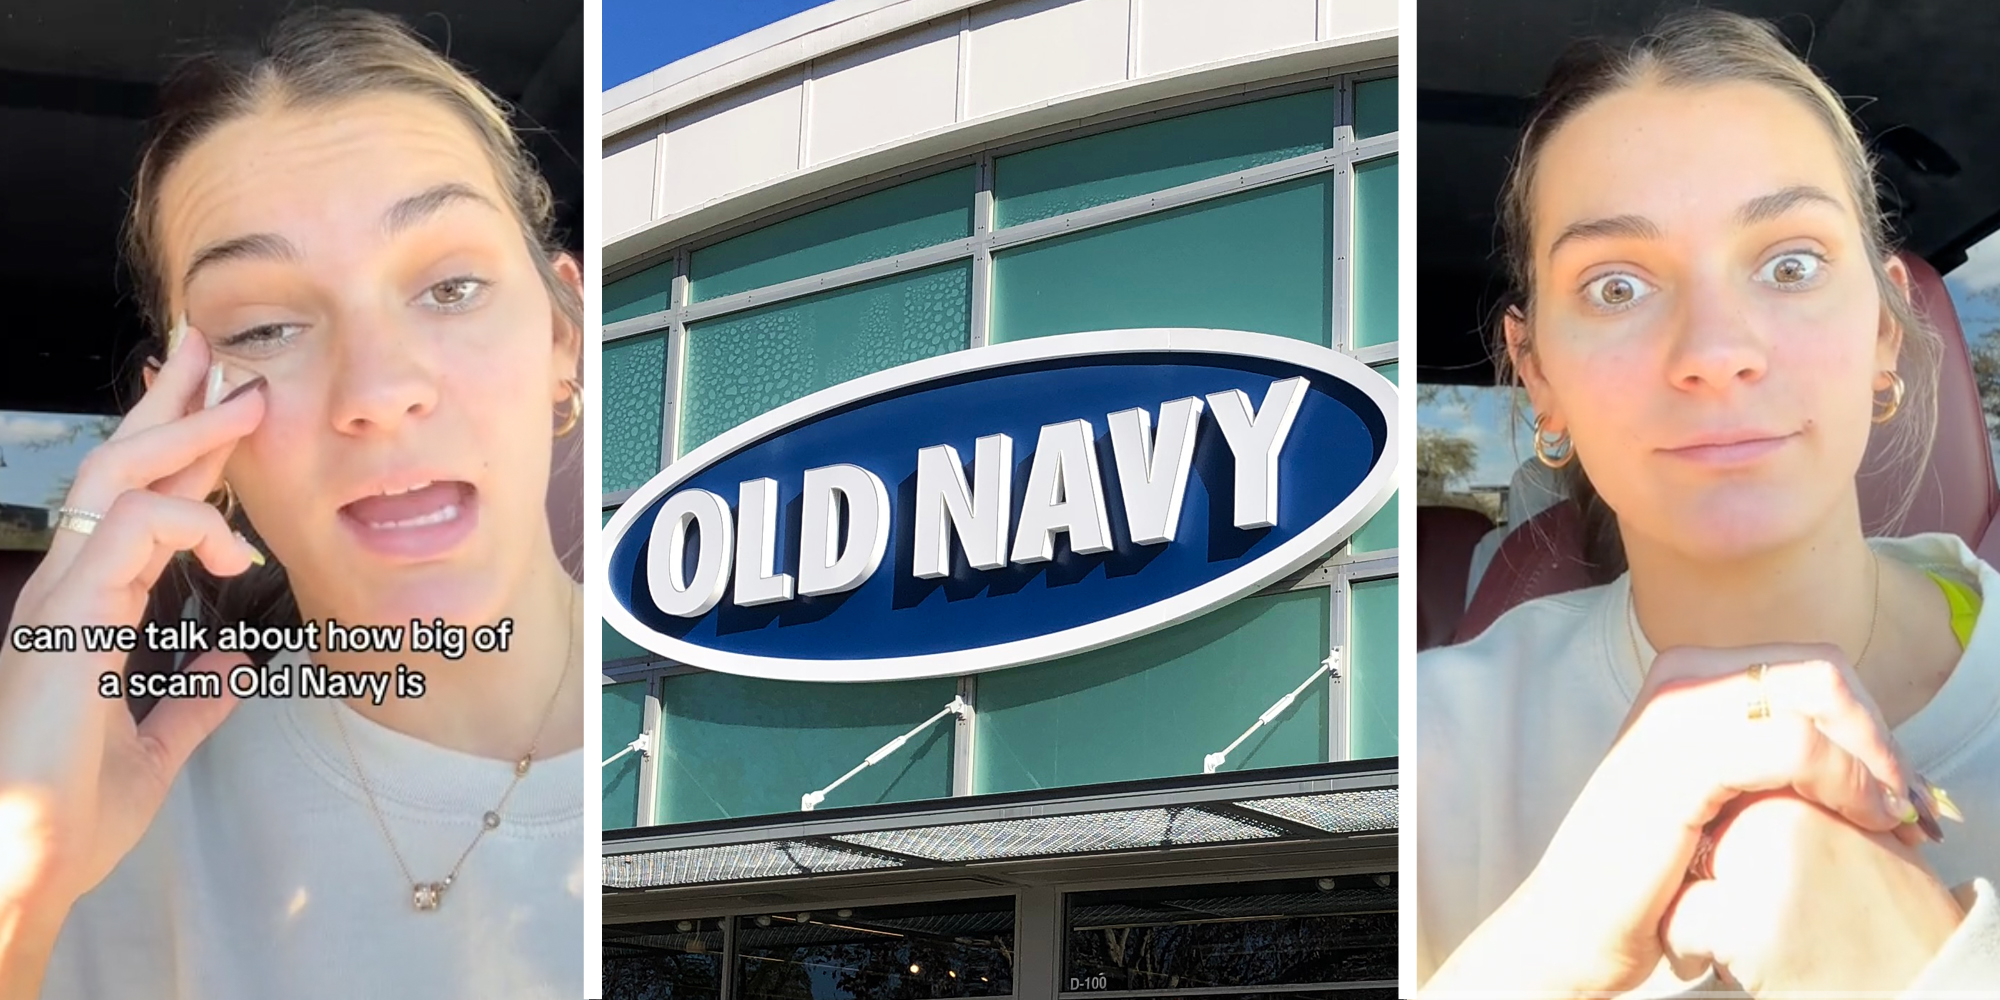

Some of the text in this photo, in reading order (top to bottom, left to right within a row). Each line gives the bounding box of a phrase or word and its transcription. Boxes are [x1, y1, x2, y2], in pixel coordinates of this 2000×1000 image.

[647, 376, 1311, 618] OLD NAVY
[1070, 976, 1107, 990] D-100
